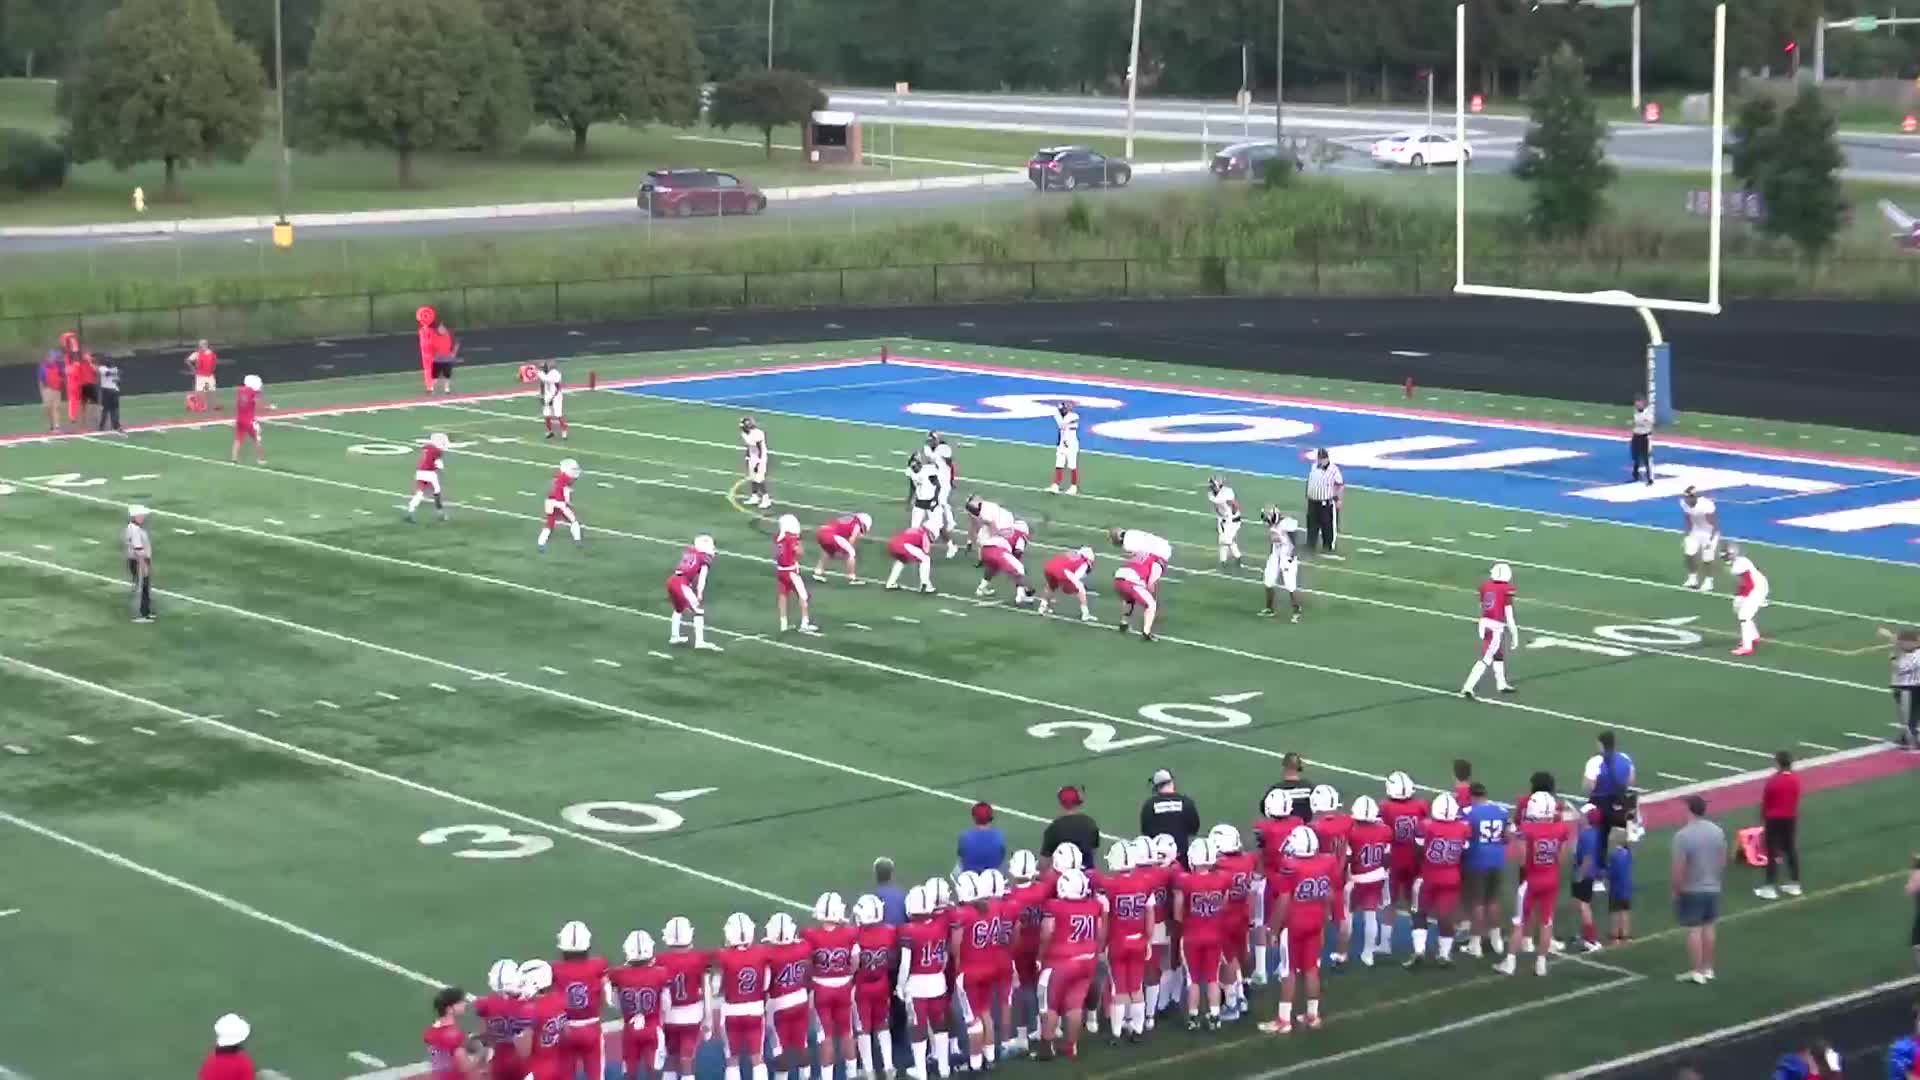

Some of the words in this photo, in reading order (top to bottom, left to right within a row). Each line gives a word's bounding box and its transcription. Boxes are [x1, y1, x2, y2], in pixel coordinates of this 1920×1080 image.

[1479, 819, 1503, 843] 52
[1067, 914, 1094, 943] 71
[921, 940, 947, 967] 14
[674, 971, 688, 1001] 1
[738, 966, 758, 994] 2
